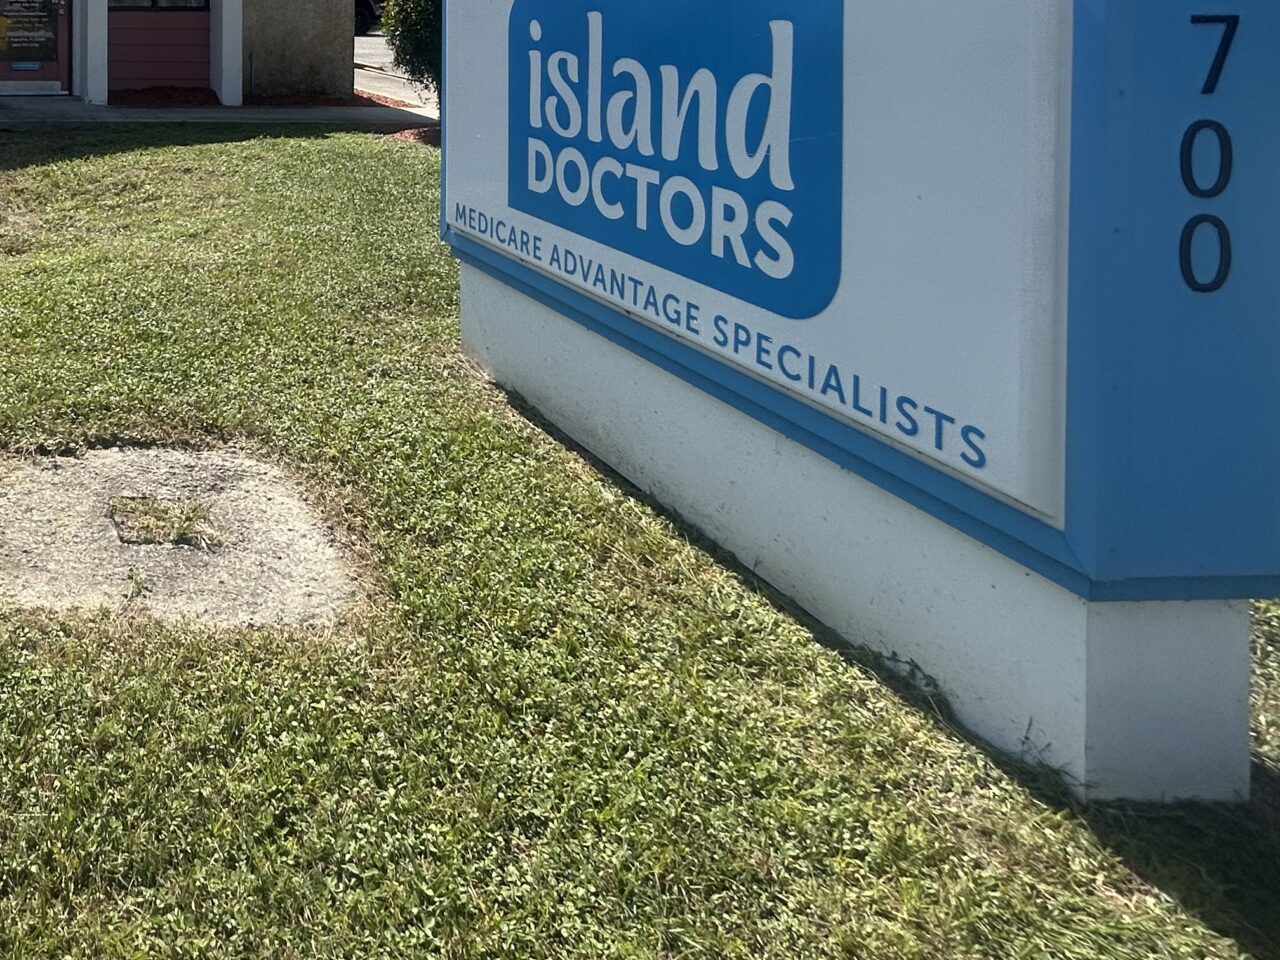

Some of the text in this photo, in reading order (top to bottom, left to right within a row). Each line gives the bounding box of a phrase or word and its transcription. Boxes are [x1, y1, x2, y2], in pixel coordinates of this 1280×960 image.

[528, 11, 795, 191] island
[528, 137, 795, 279] DOCTORS
[455, 202, 987, 469] MEDICARE ADVANTAGE SPECIALISTS
